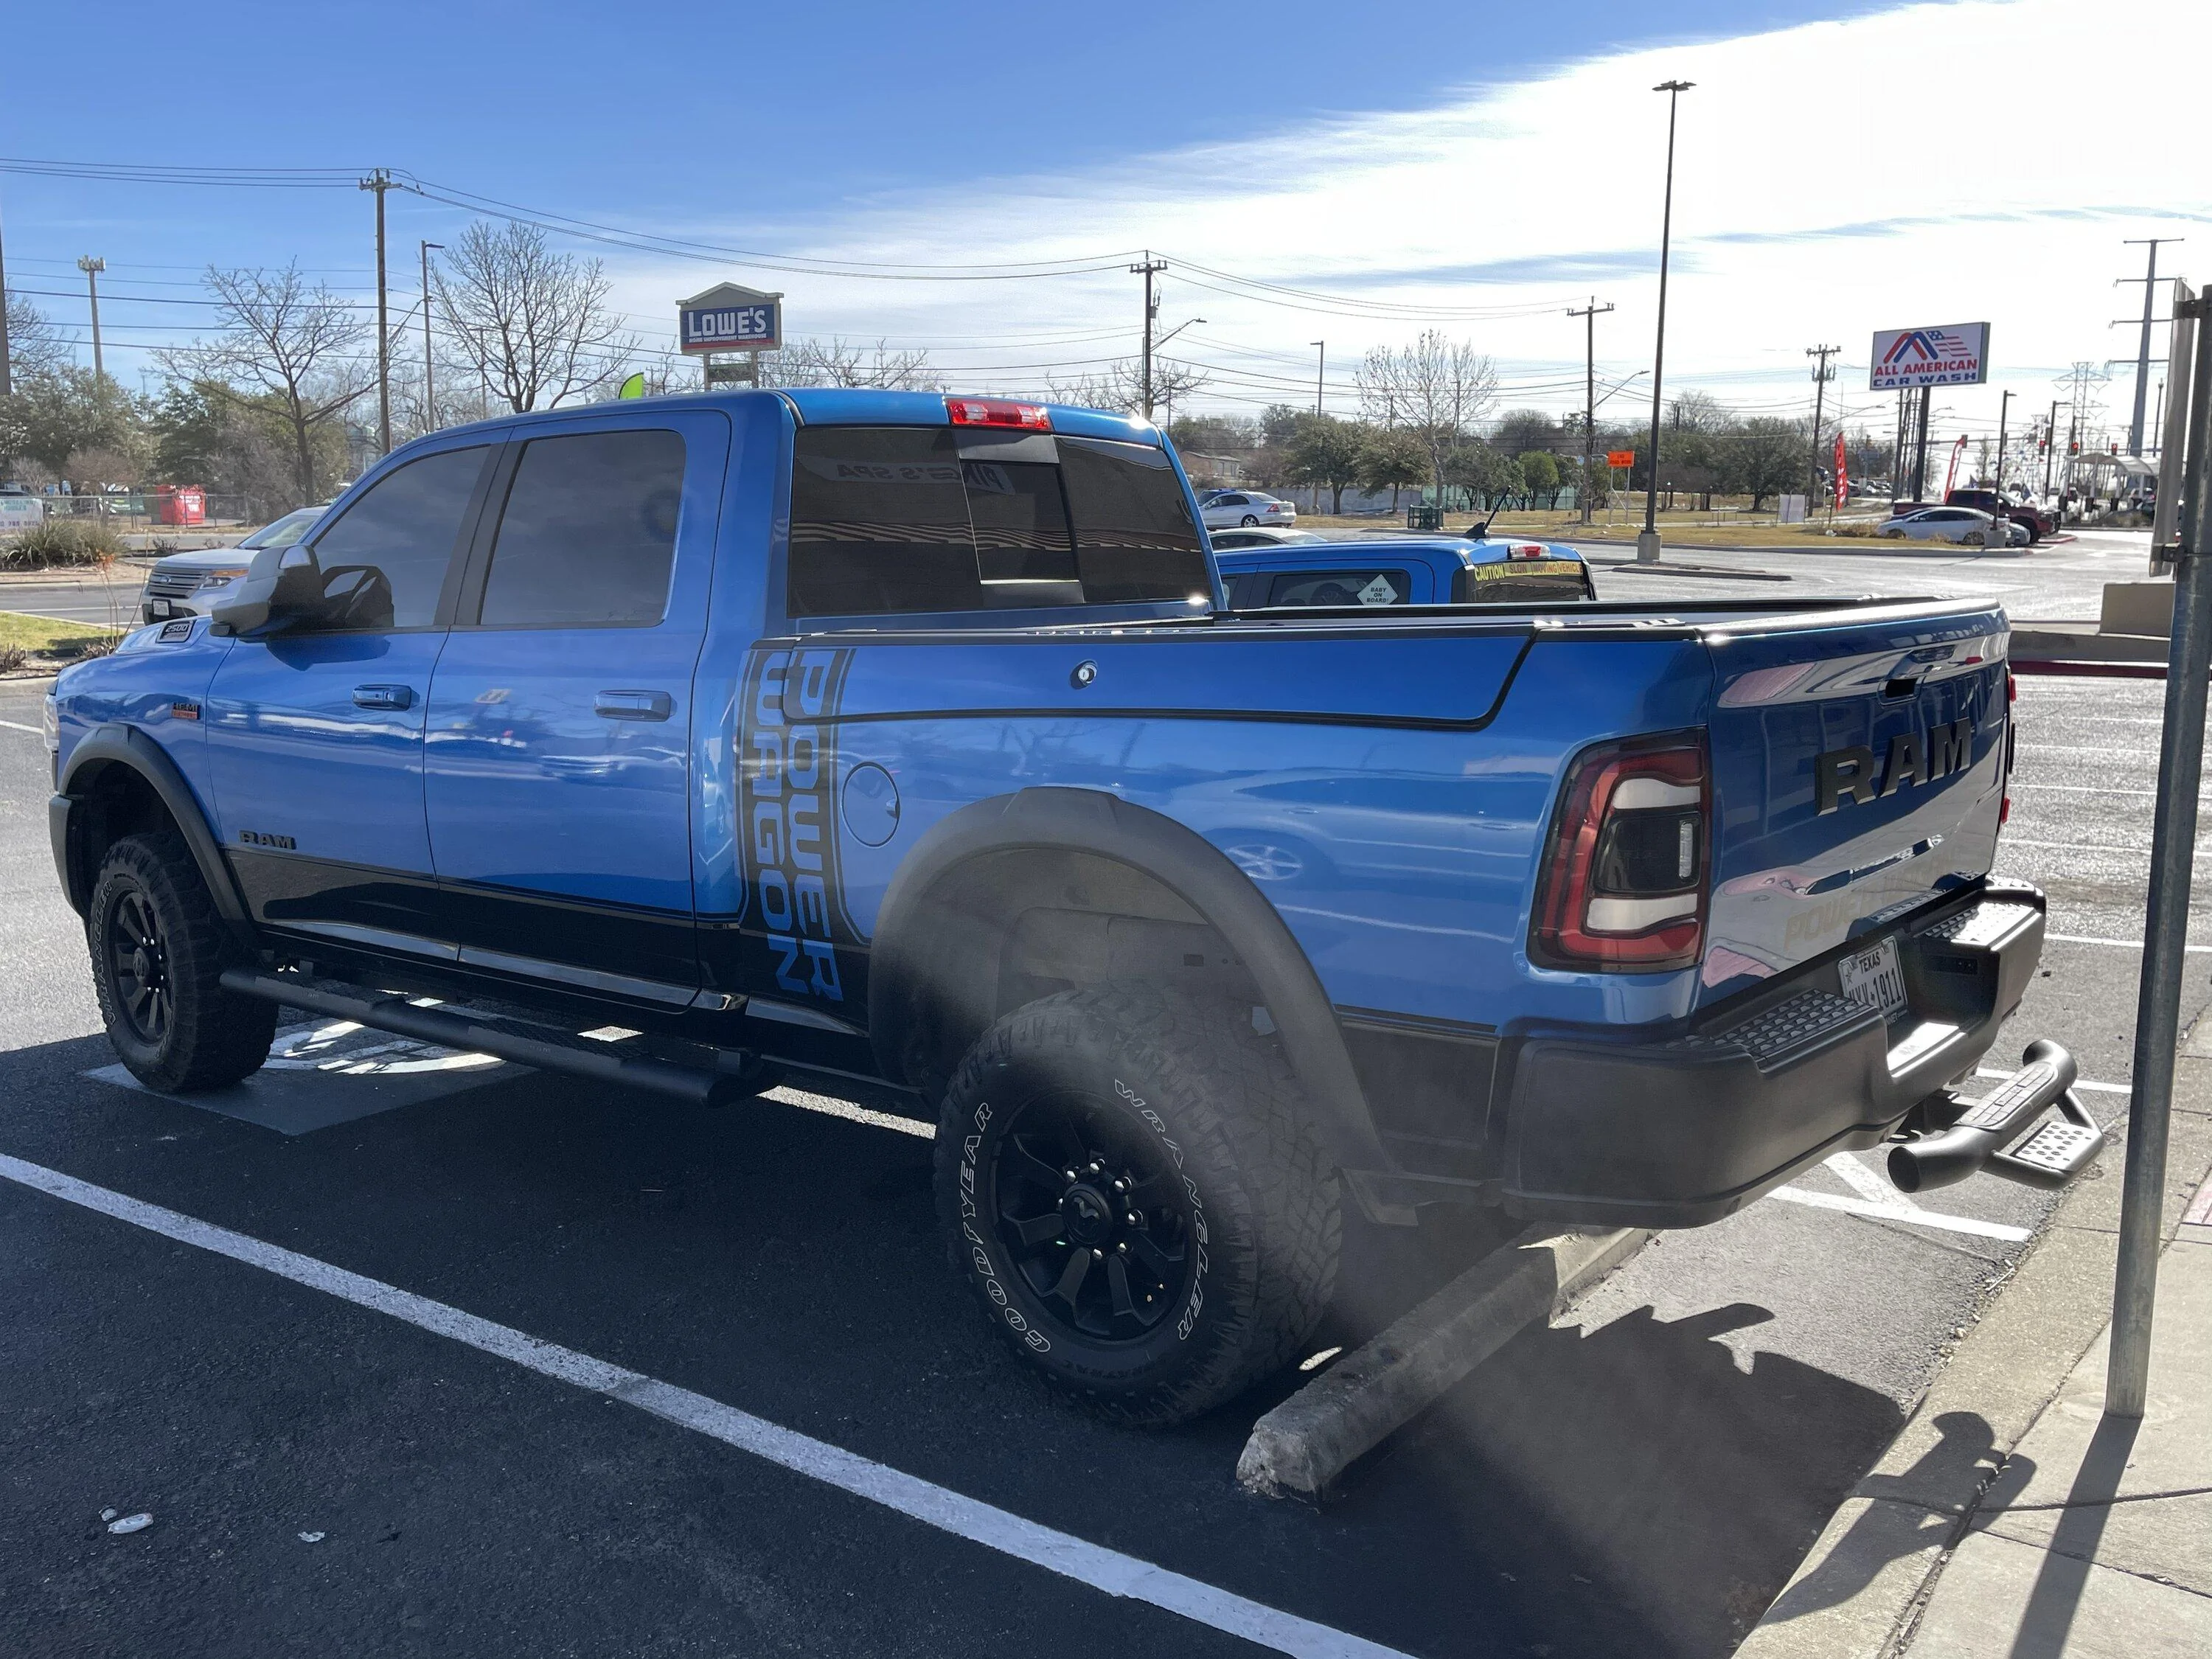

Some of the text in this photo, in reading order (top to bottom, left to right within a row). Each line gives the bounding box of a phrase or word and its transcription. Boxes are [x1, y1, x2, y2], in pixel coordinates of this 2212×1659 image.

[688, 307, 766, 337] LOWE'S
[1873, 372, 1976, 387] CAR WASH
[1874, 359, 1978, 377] ALL AMERICAN
[1475, 564, 1505, 582] CAUTION
[1509, 563, 1527, 574] SLOW
[1532, 562, 1557, 574] MOVING
[1815, 717, 1974, 816] RAM
[238, 830, 296, 849] RAM
[752, 650, 810, 993] WAGON
[787, 650, 844, 1001] POWER
[94, 880, 116, 1026] WRANGLER
[1859, 951, 1881, 973] TEXAS
[961, 1103, 1051, 1352] GOODYEAR
[1115, 1079, 1208, 1340] WRANGLER
